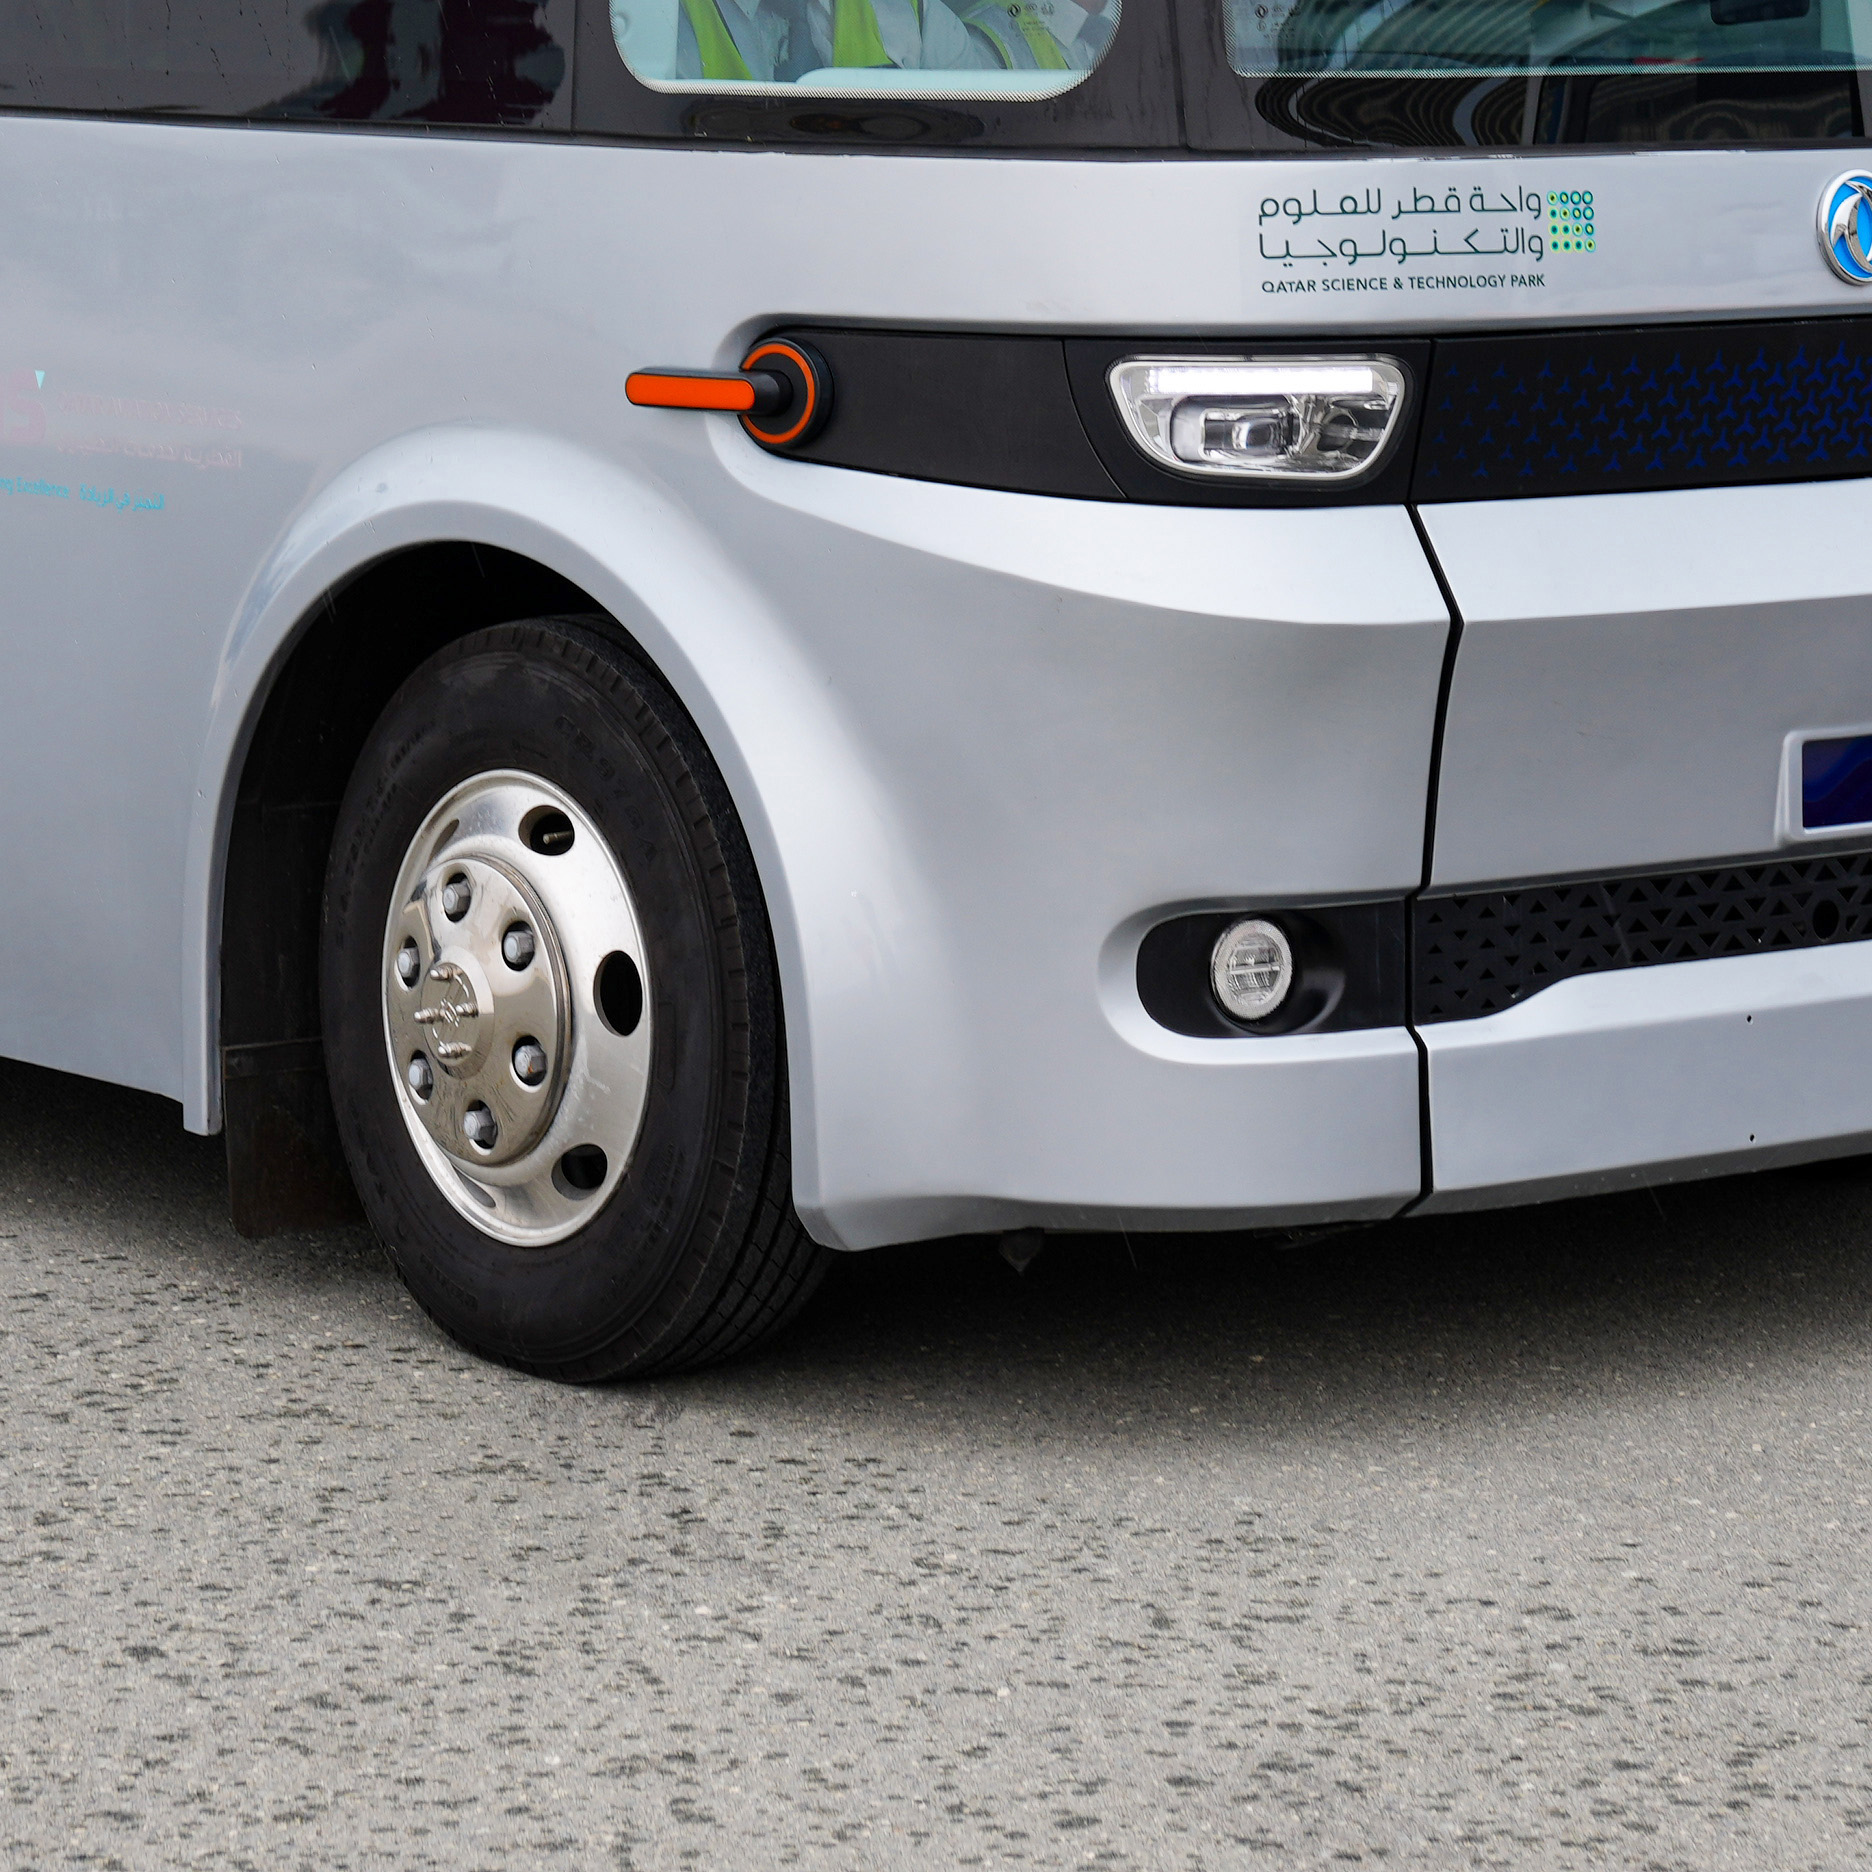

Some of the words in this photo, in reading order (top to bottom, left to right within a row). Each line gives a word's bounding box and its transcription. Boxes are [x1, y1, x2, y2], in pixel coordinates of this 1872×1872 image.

[1259, 187, 1381, 226] للعلوم
[1391, 186, 1461, 220] قطر
[1469, 184, 1541, 220] واحة
[1259, 226, 1543, 267] والتكنولوجيا
[1261, 279, 1317, 293] QATAR
[1322, 277, 1387, 291] SCIENCE
[1393, 277, 1403, 290] &
[1408, 274, 1506, 289] TECHNOLOGY
[1511, 273, 1545, 288] PARK
